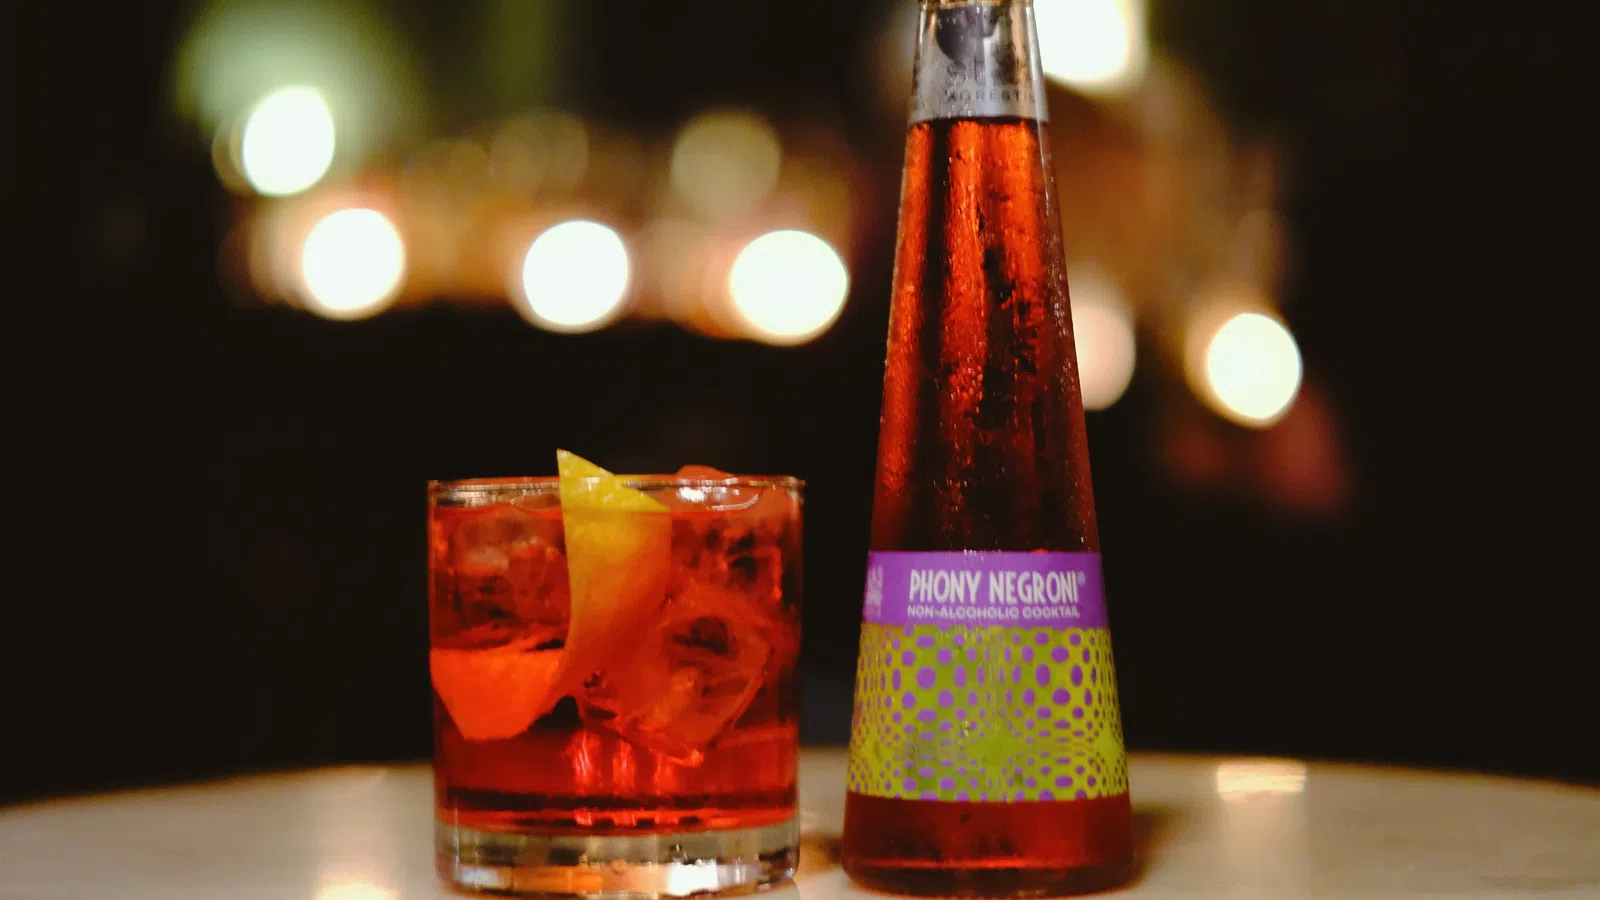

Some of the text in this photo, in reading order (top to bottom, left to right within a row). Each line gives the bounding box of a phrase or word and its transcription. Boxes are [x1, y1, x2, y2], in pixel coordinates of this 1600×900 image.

[909, 569, 981, 605] PHONY
[907, 605, 1080, 620] NON-ALCOHOLIC COCKTAIL
